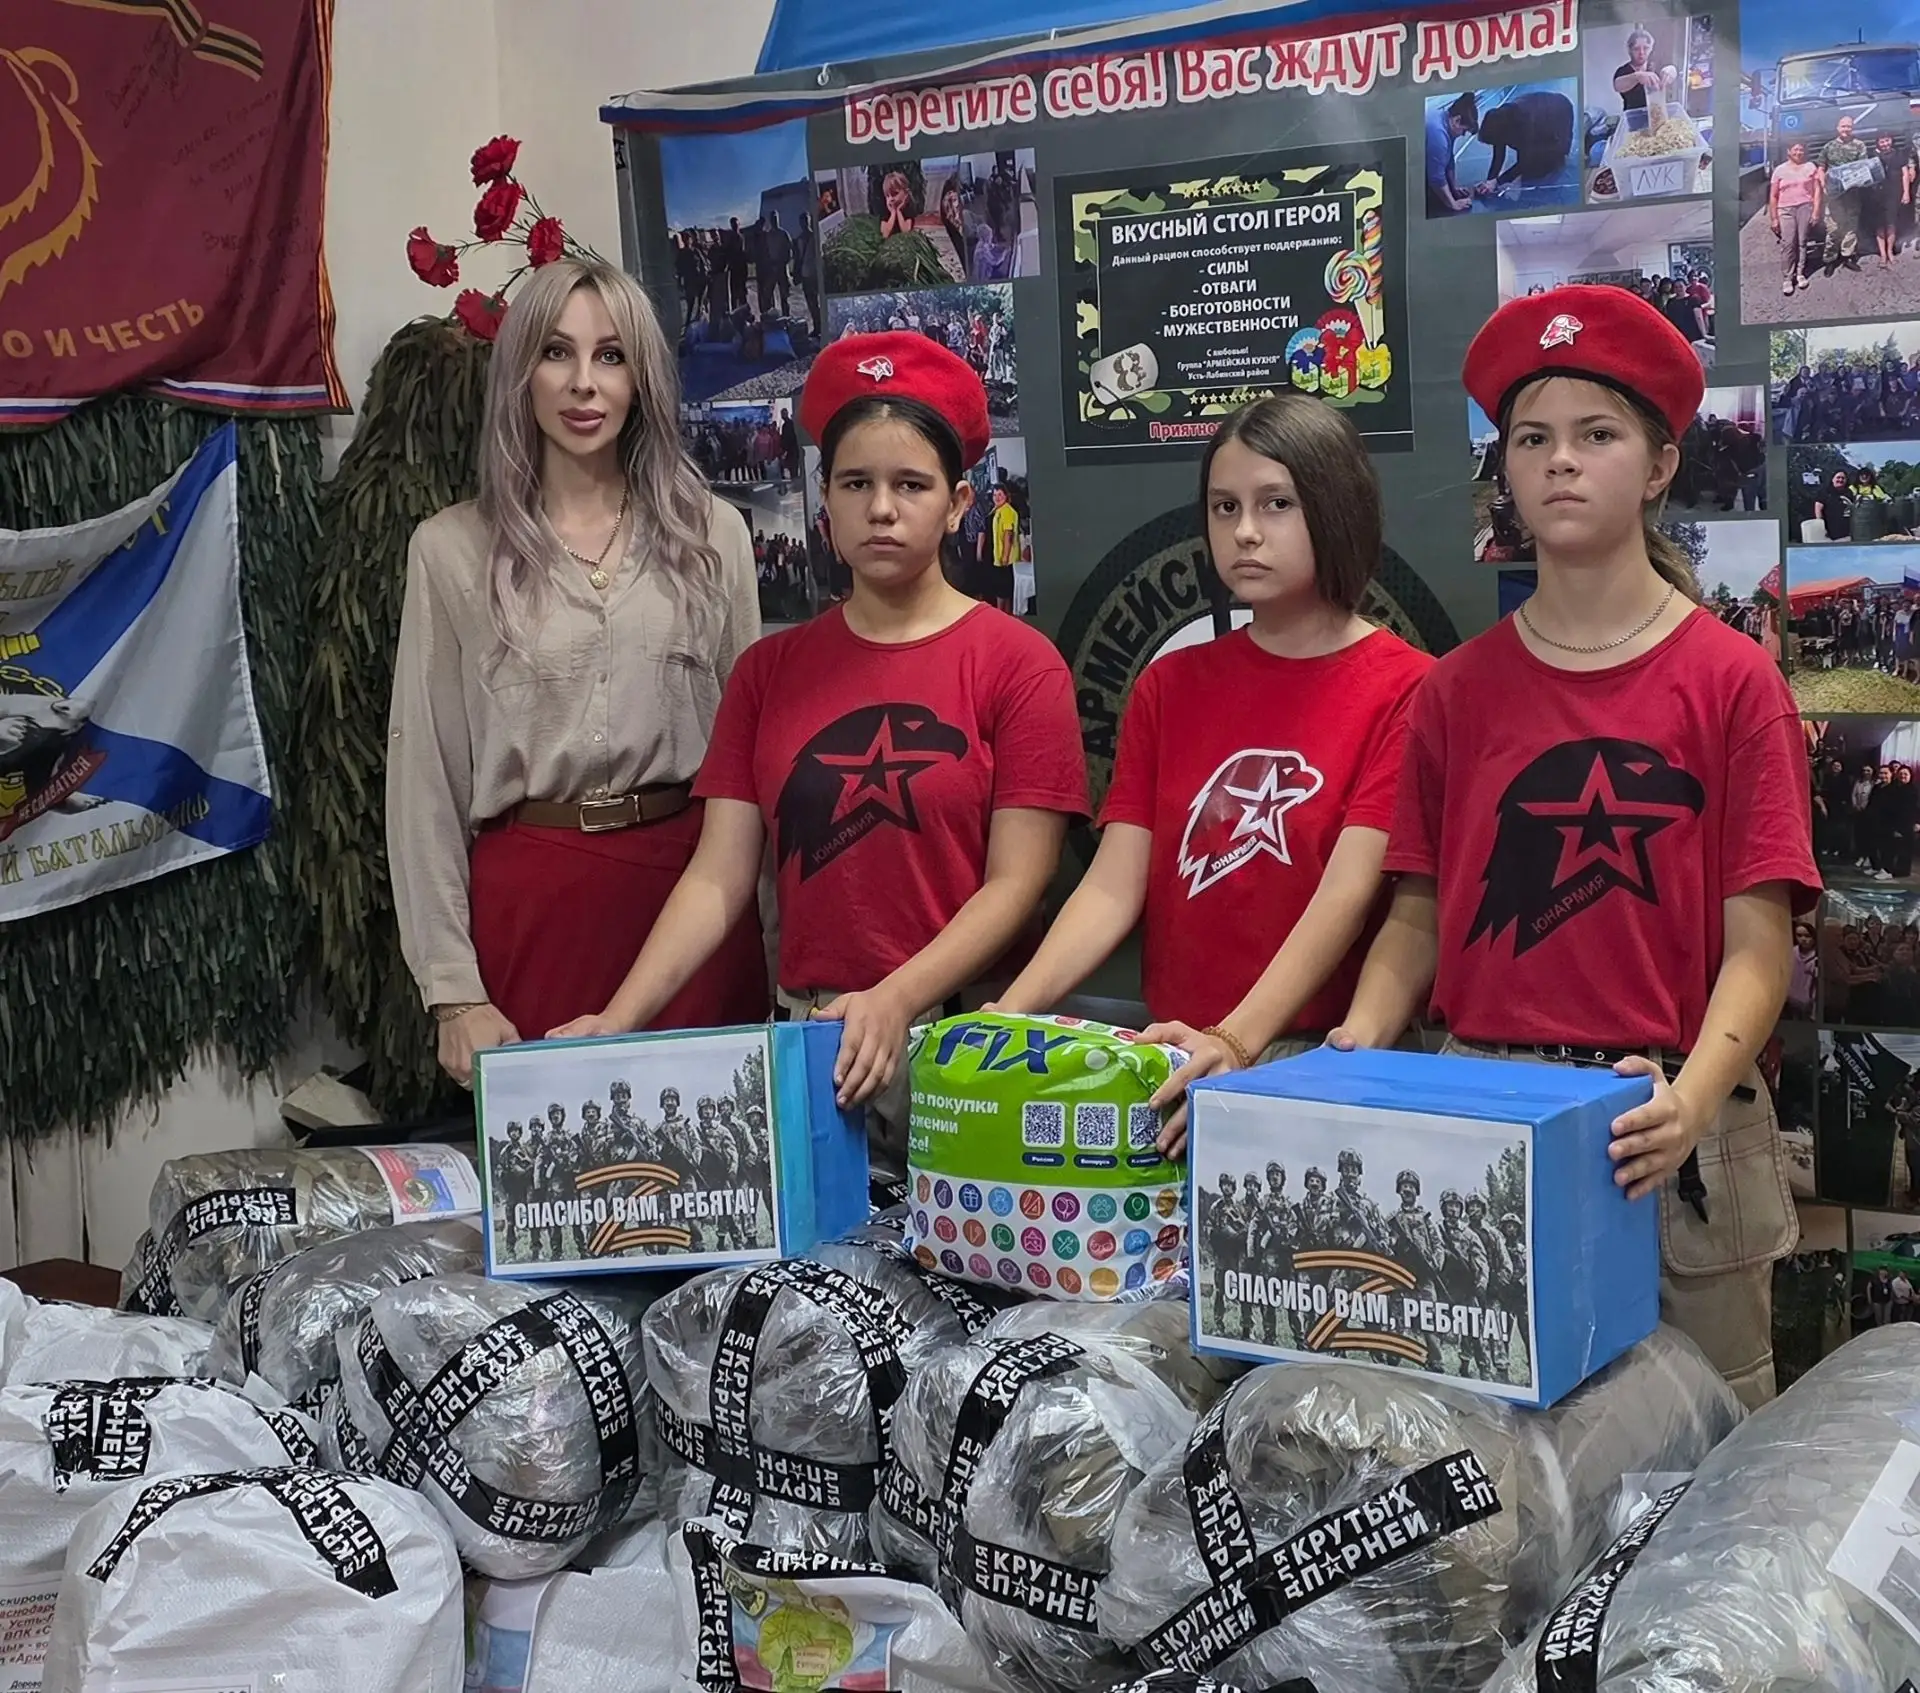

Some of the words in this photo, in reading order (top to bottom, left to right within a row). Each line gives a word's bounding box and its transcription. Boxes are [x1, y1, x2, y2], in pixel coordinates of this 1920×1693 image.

[847, 82, 1034, 148] Берегите
[1050, 51, 1163, 117] себя!
[1176, 48, 1258, 98] Вас
[1271, 31, 1403, 95] ждут
[1417, 0, 1575, 79] дома!
[1636, 165, 1676, 191] ЛУК
[1111, 212, 1208, 245] ВКУСНЫЙ
[1213, 209, 1270, 233] СТОЛ
[1274, 202, 1341, 228] ГЕРОЯ
[1112, 251, 1151, 267] Данный
[1152, 250, 1190, 265] рацион
[1191, 243, 1262, 259] способствует
[1263, 235, 1343, 252] поддержанию:
[1207, 260, 1249, 276] СИЛЫ
[1169, 296, 1291, 318] БОЕГОТОВНОСТИ
[1201, 279, 1258, 296] ОТВАГИ
[43, 327, 77, 358] И
[83, 298, 205, 353] ЧЕСТЬ
[1163, 315, 1299, 338] МУЖЕСТВЕННОСТИ
[1150, 421, 1222, 442] Приятно
[811, 811, 876, 864] ЮНАРМИЯ
[1211, 835, 1258, 872] ЮНАРМИЯ
[1531, 874, 1606, 934] ЮНАРМИЯ
[926, 1094, 999, 1116] покупки
[514, 1196, 606, 1230] СПАСИБО
[612, 1194, 666, 1224] ВАМ,
[671, 1188, 757, 1221] РЕБЯТА!
[1223, 1269, 1328, 1316] СПАСИБО
[1334, 1289, 1396, 1331] ВАМ,
[1403, 1297, 1511, 1341] РЕБЯТА!
[724, 1329, 756, 1351] ДЛЯ
[1444, 1460, 1479, 1512] ДЛЯ
[1291, 1484, 1417, 1566] КРУТЫХ
[1272, 1548, 1305, 1600] ДЛЯ
[1163, 1577, 1248, 1652] КРУТЫХ
